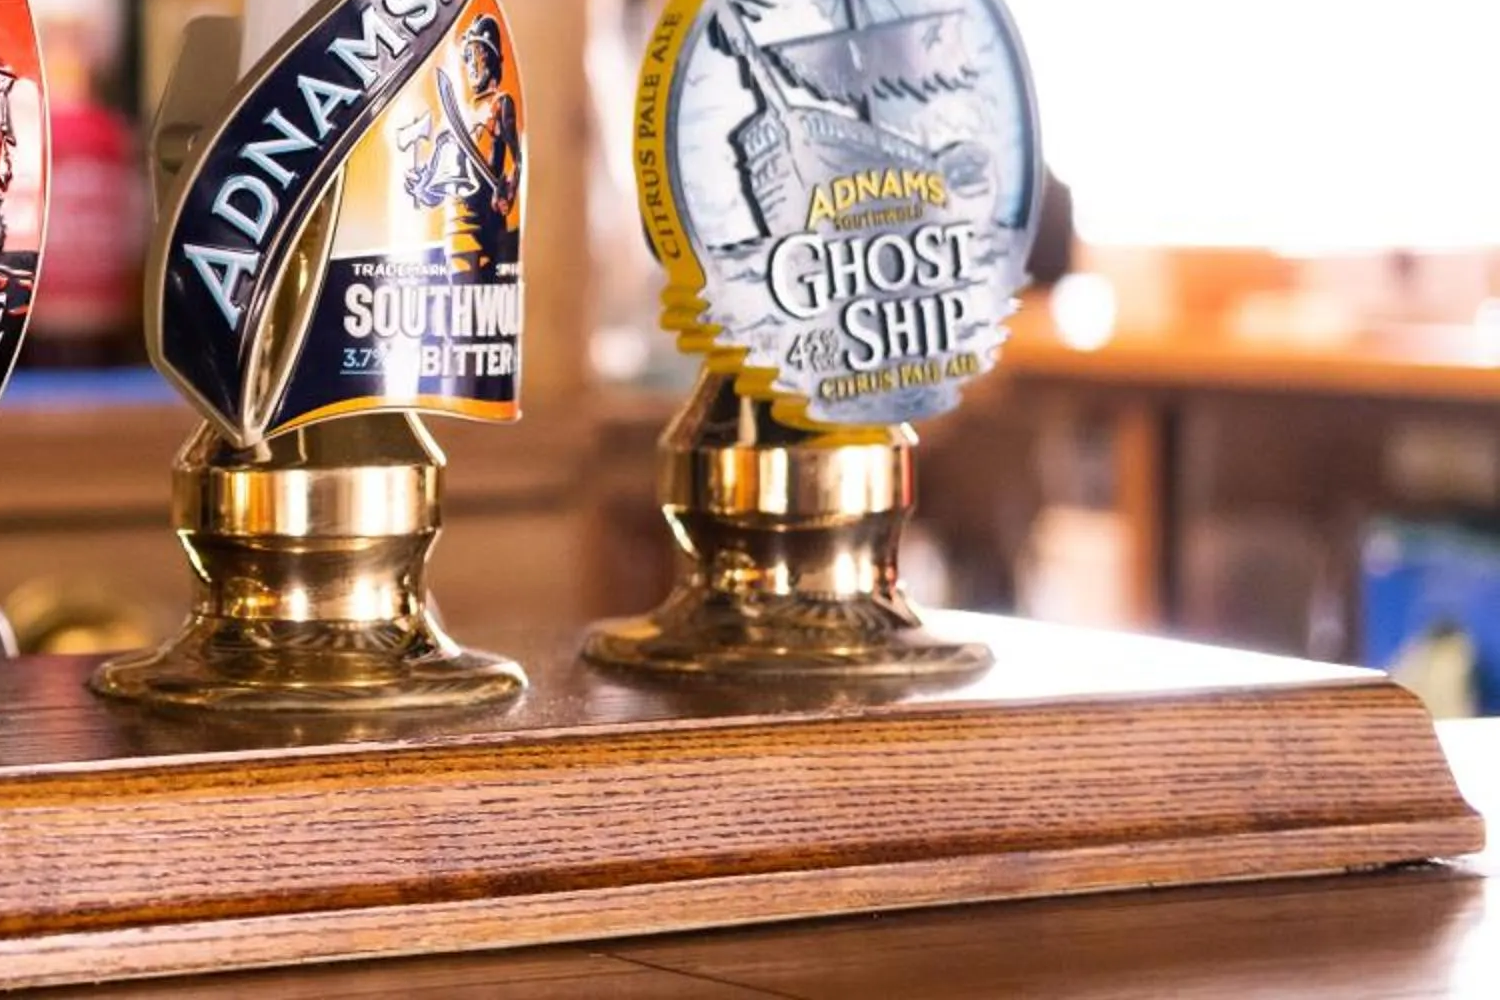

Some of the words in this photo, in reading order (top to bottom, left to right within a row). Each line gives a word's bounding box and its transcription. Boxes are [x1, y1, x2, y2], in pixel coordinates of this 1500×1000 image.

[653, 11, 683, 63] ALE
[638, 74, 661, 141] PALE
[638, 149, 682, 261] CITRUS
[804, 168, 947, 232] ADNAMS
[766, 221, 975, 320] GHOST
[421, 343, 513, 377] BITTER
[840, 293, 966, 372] SHIP
